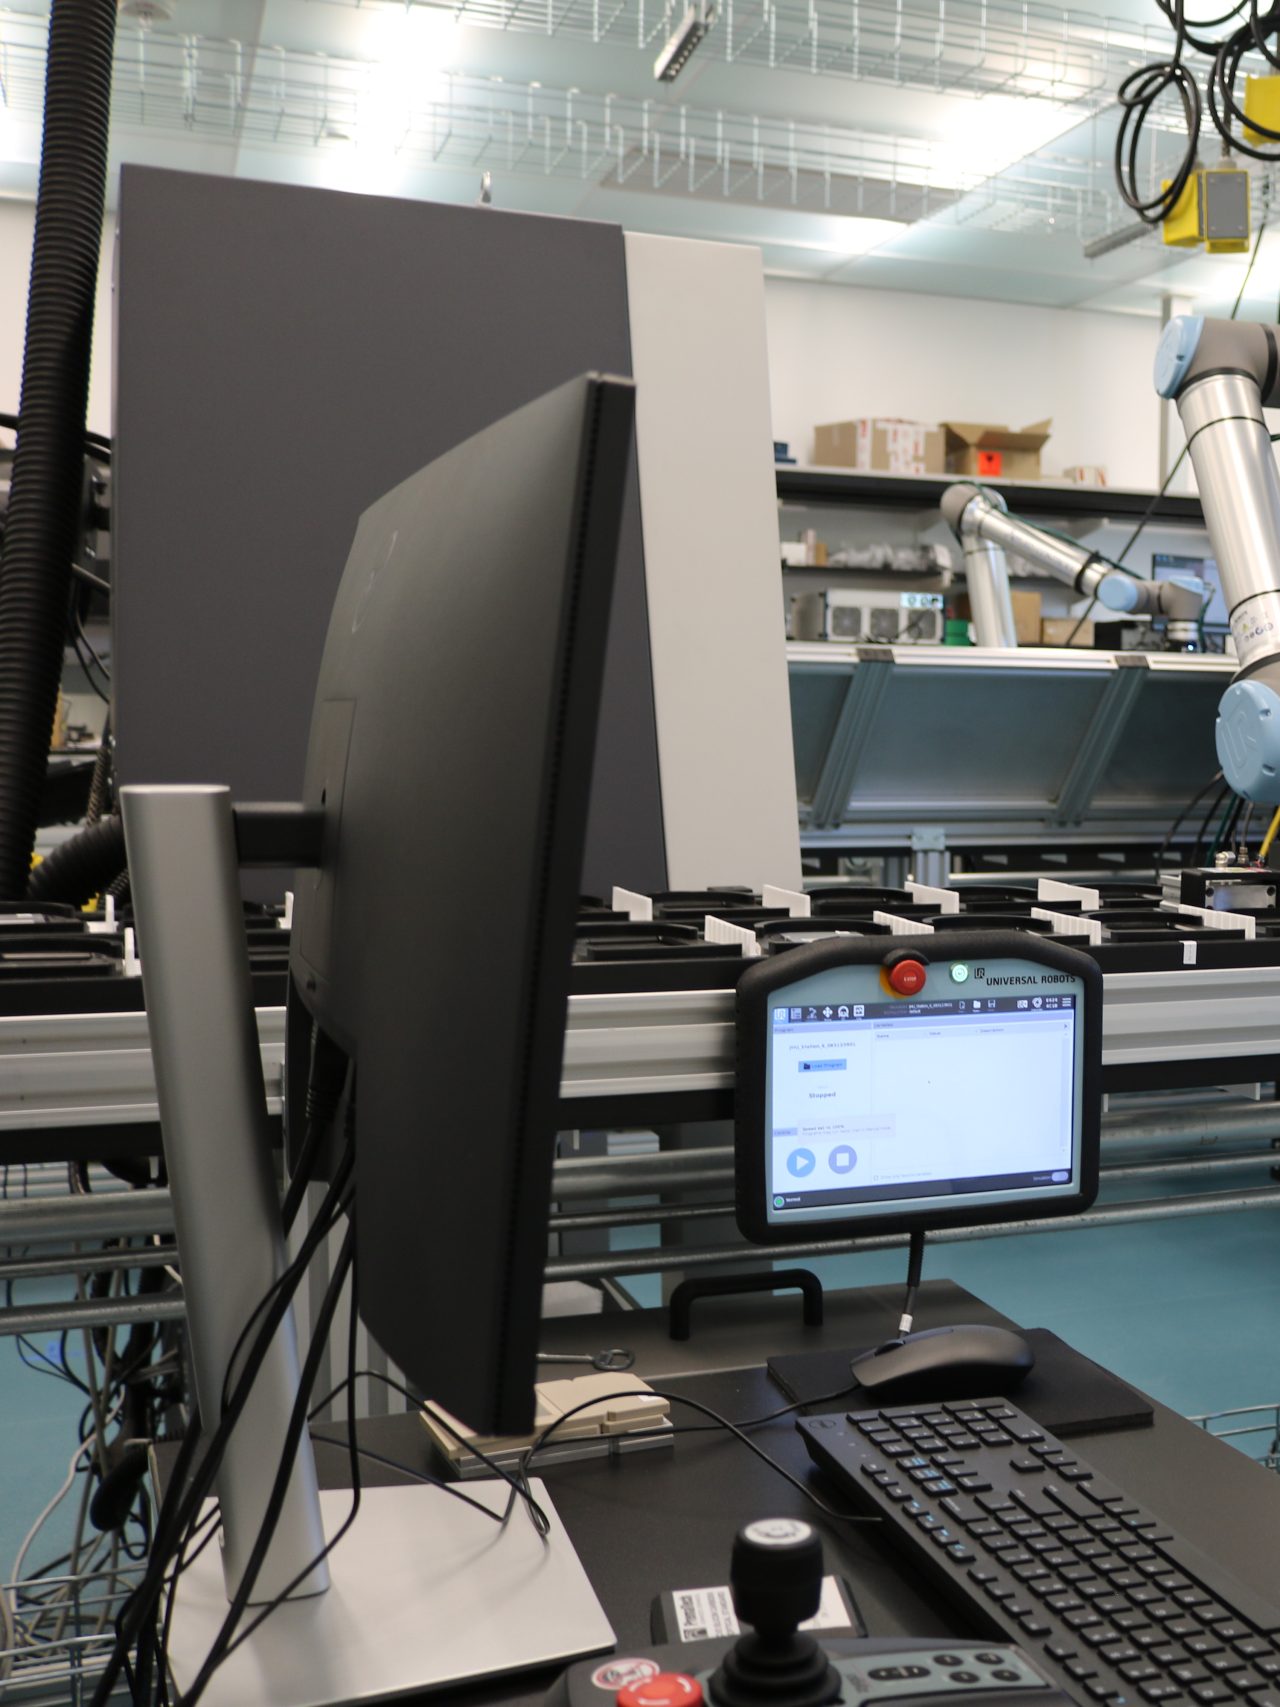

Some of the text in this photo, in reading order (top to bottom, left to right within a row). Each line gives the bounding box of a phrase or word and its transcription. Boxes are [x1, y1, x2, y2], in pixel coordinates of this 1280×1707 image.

[986, 973, 1076, 986] UNIVERSAL ROBOTS
[808, 1091, 836, 1100] Stopped
